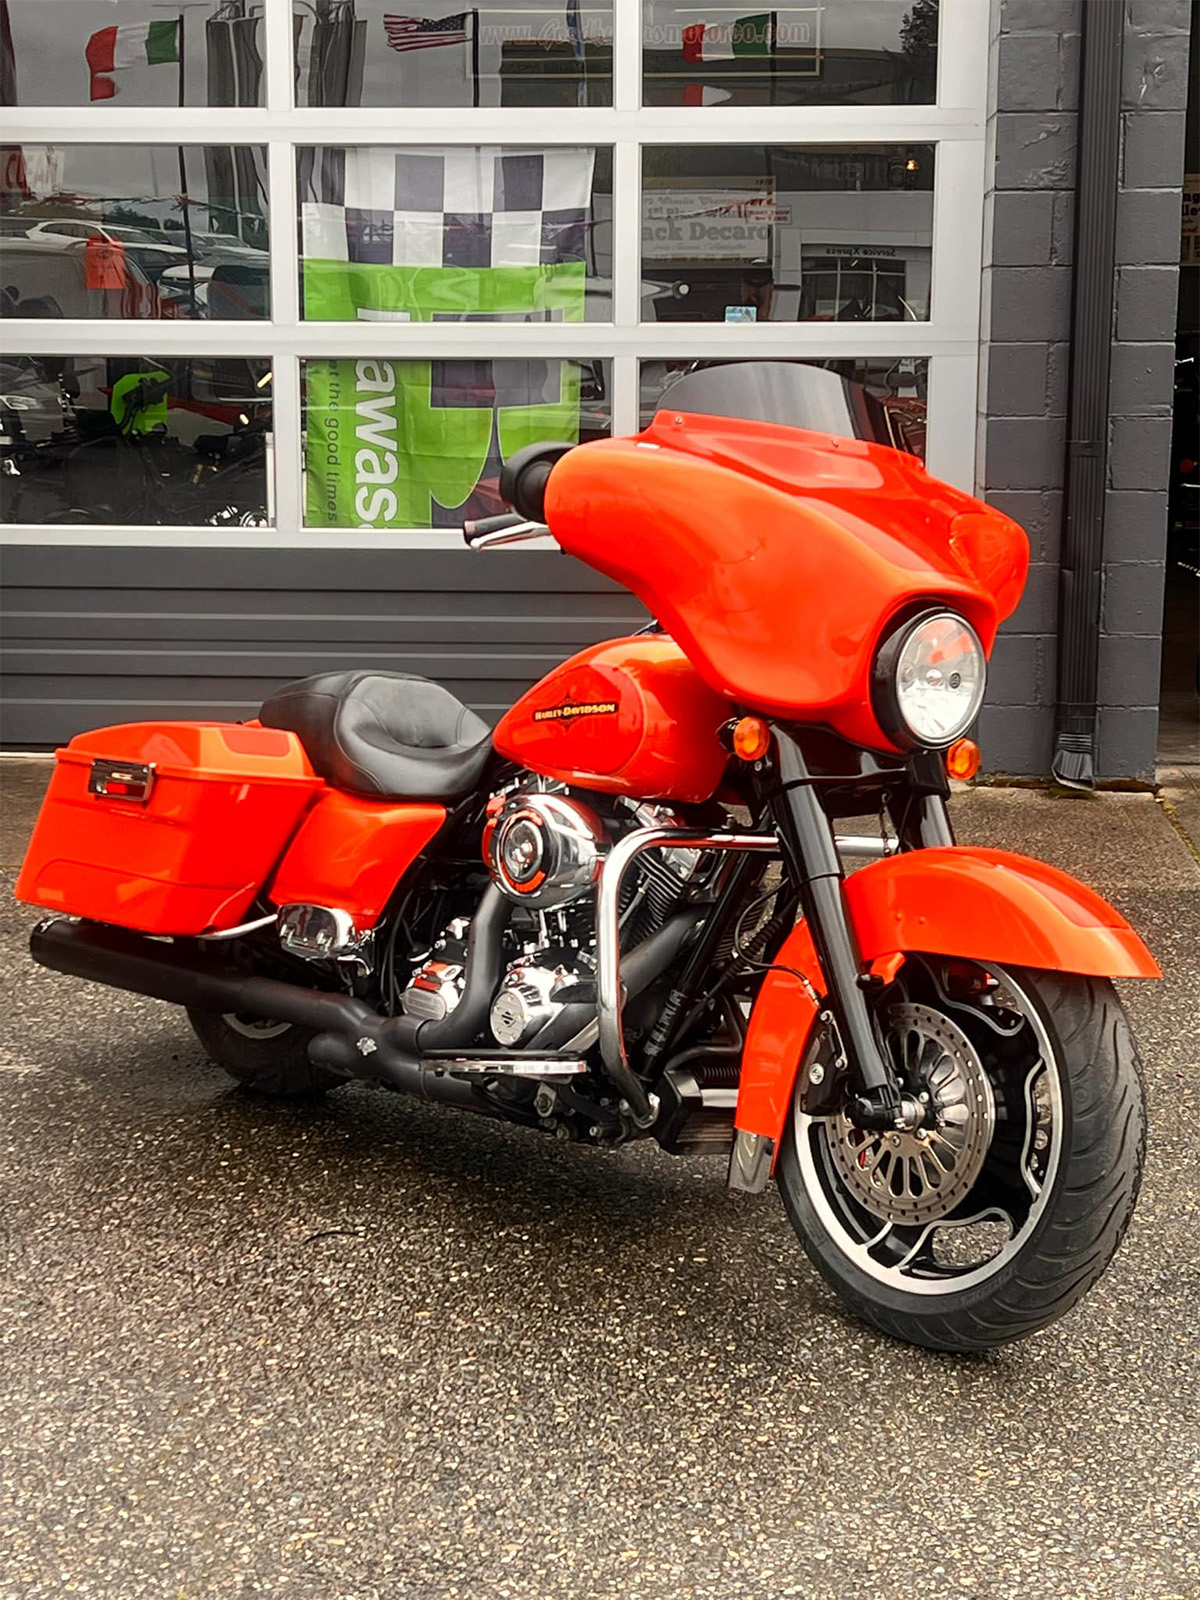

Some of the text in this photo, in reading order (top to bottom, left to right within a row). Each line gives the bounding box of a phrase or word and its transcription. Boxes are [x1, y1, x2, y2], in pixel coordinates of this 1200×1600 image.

[327, 385, 341, 412] the
[325, 417, 342, 467] good
[326, 471, 342, 522] times
